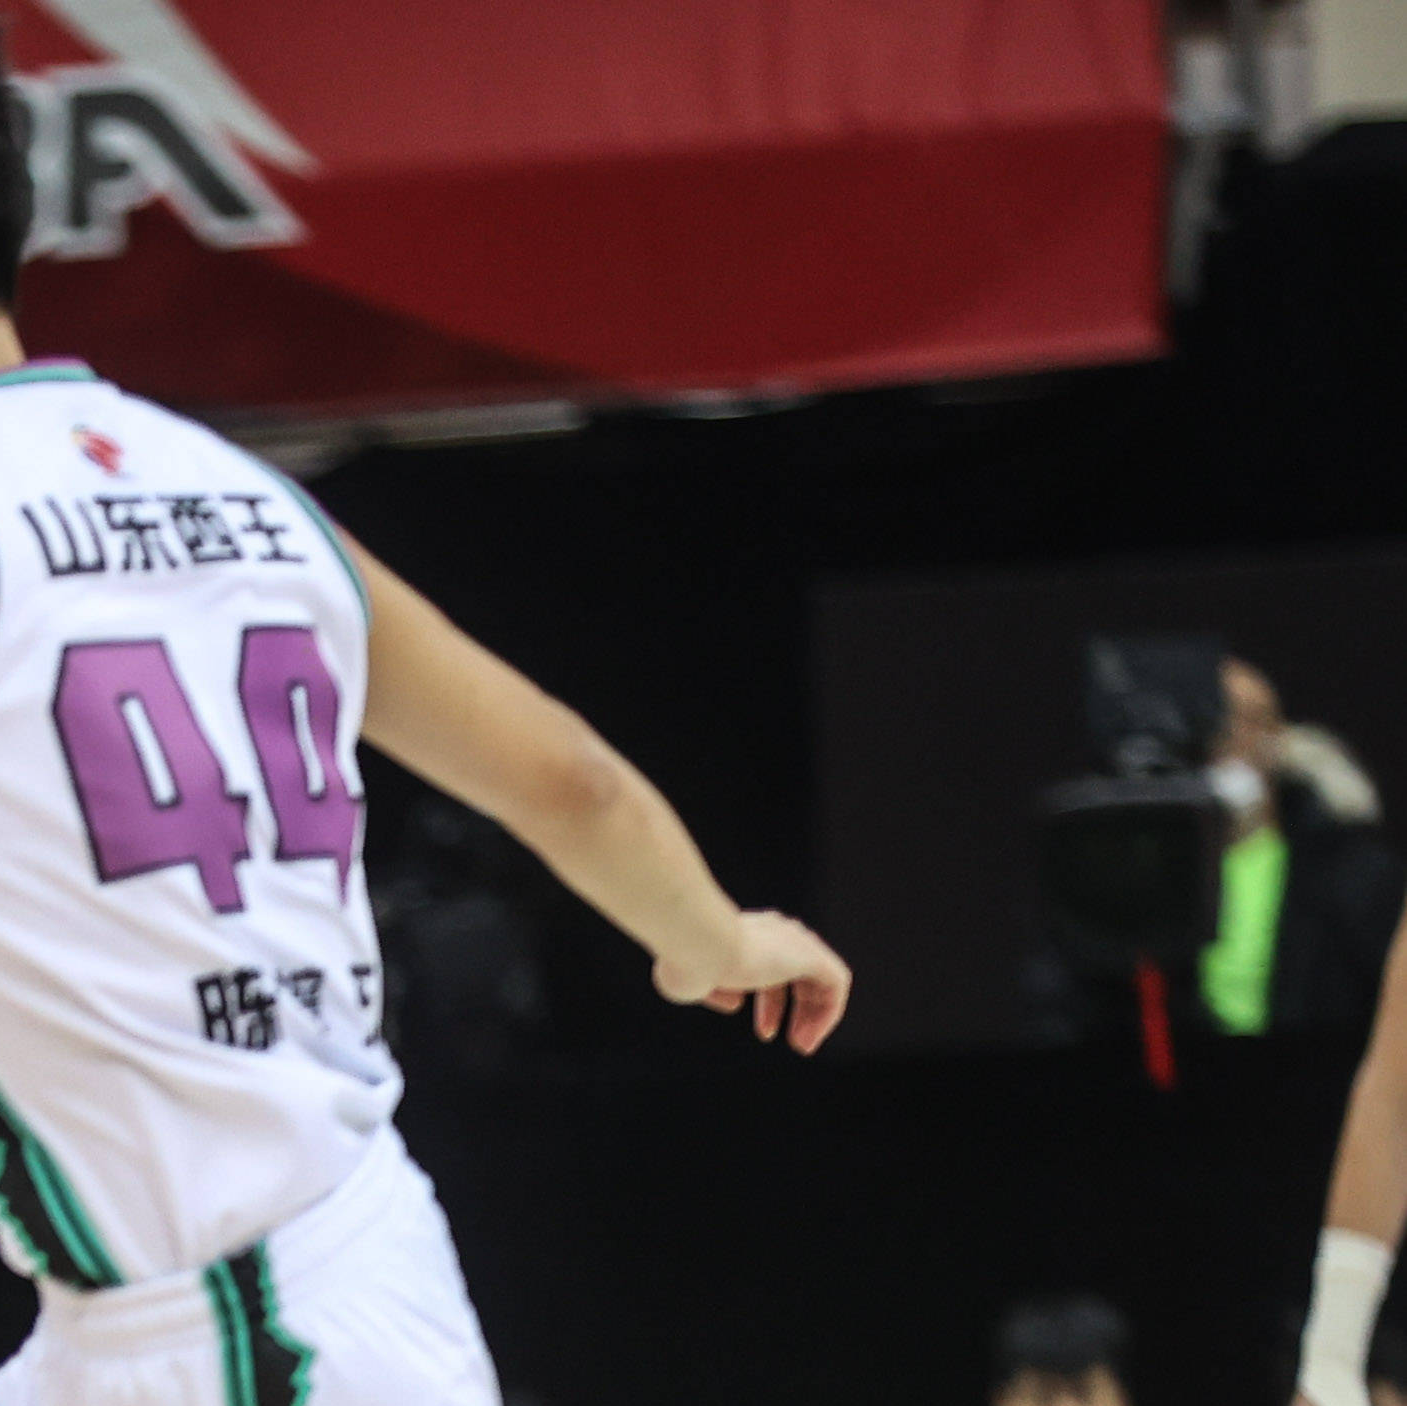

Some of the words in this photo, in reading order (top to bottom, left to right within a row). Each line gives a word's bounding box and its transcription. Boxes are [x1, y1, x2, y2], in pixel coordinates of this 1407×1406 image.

[21, 493, 308, 577] 山东西王
[53, 624, 366, 914] 44
